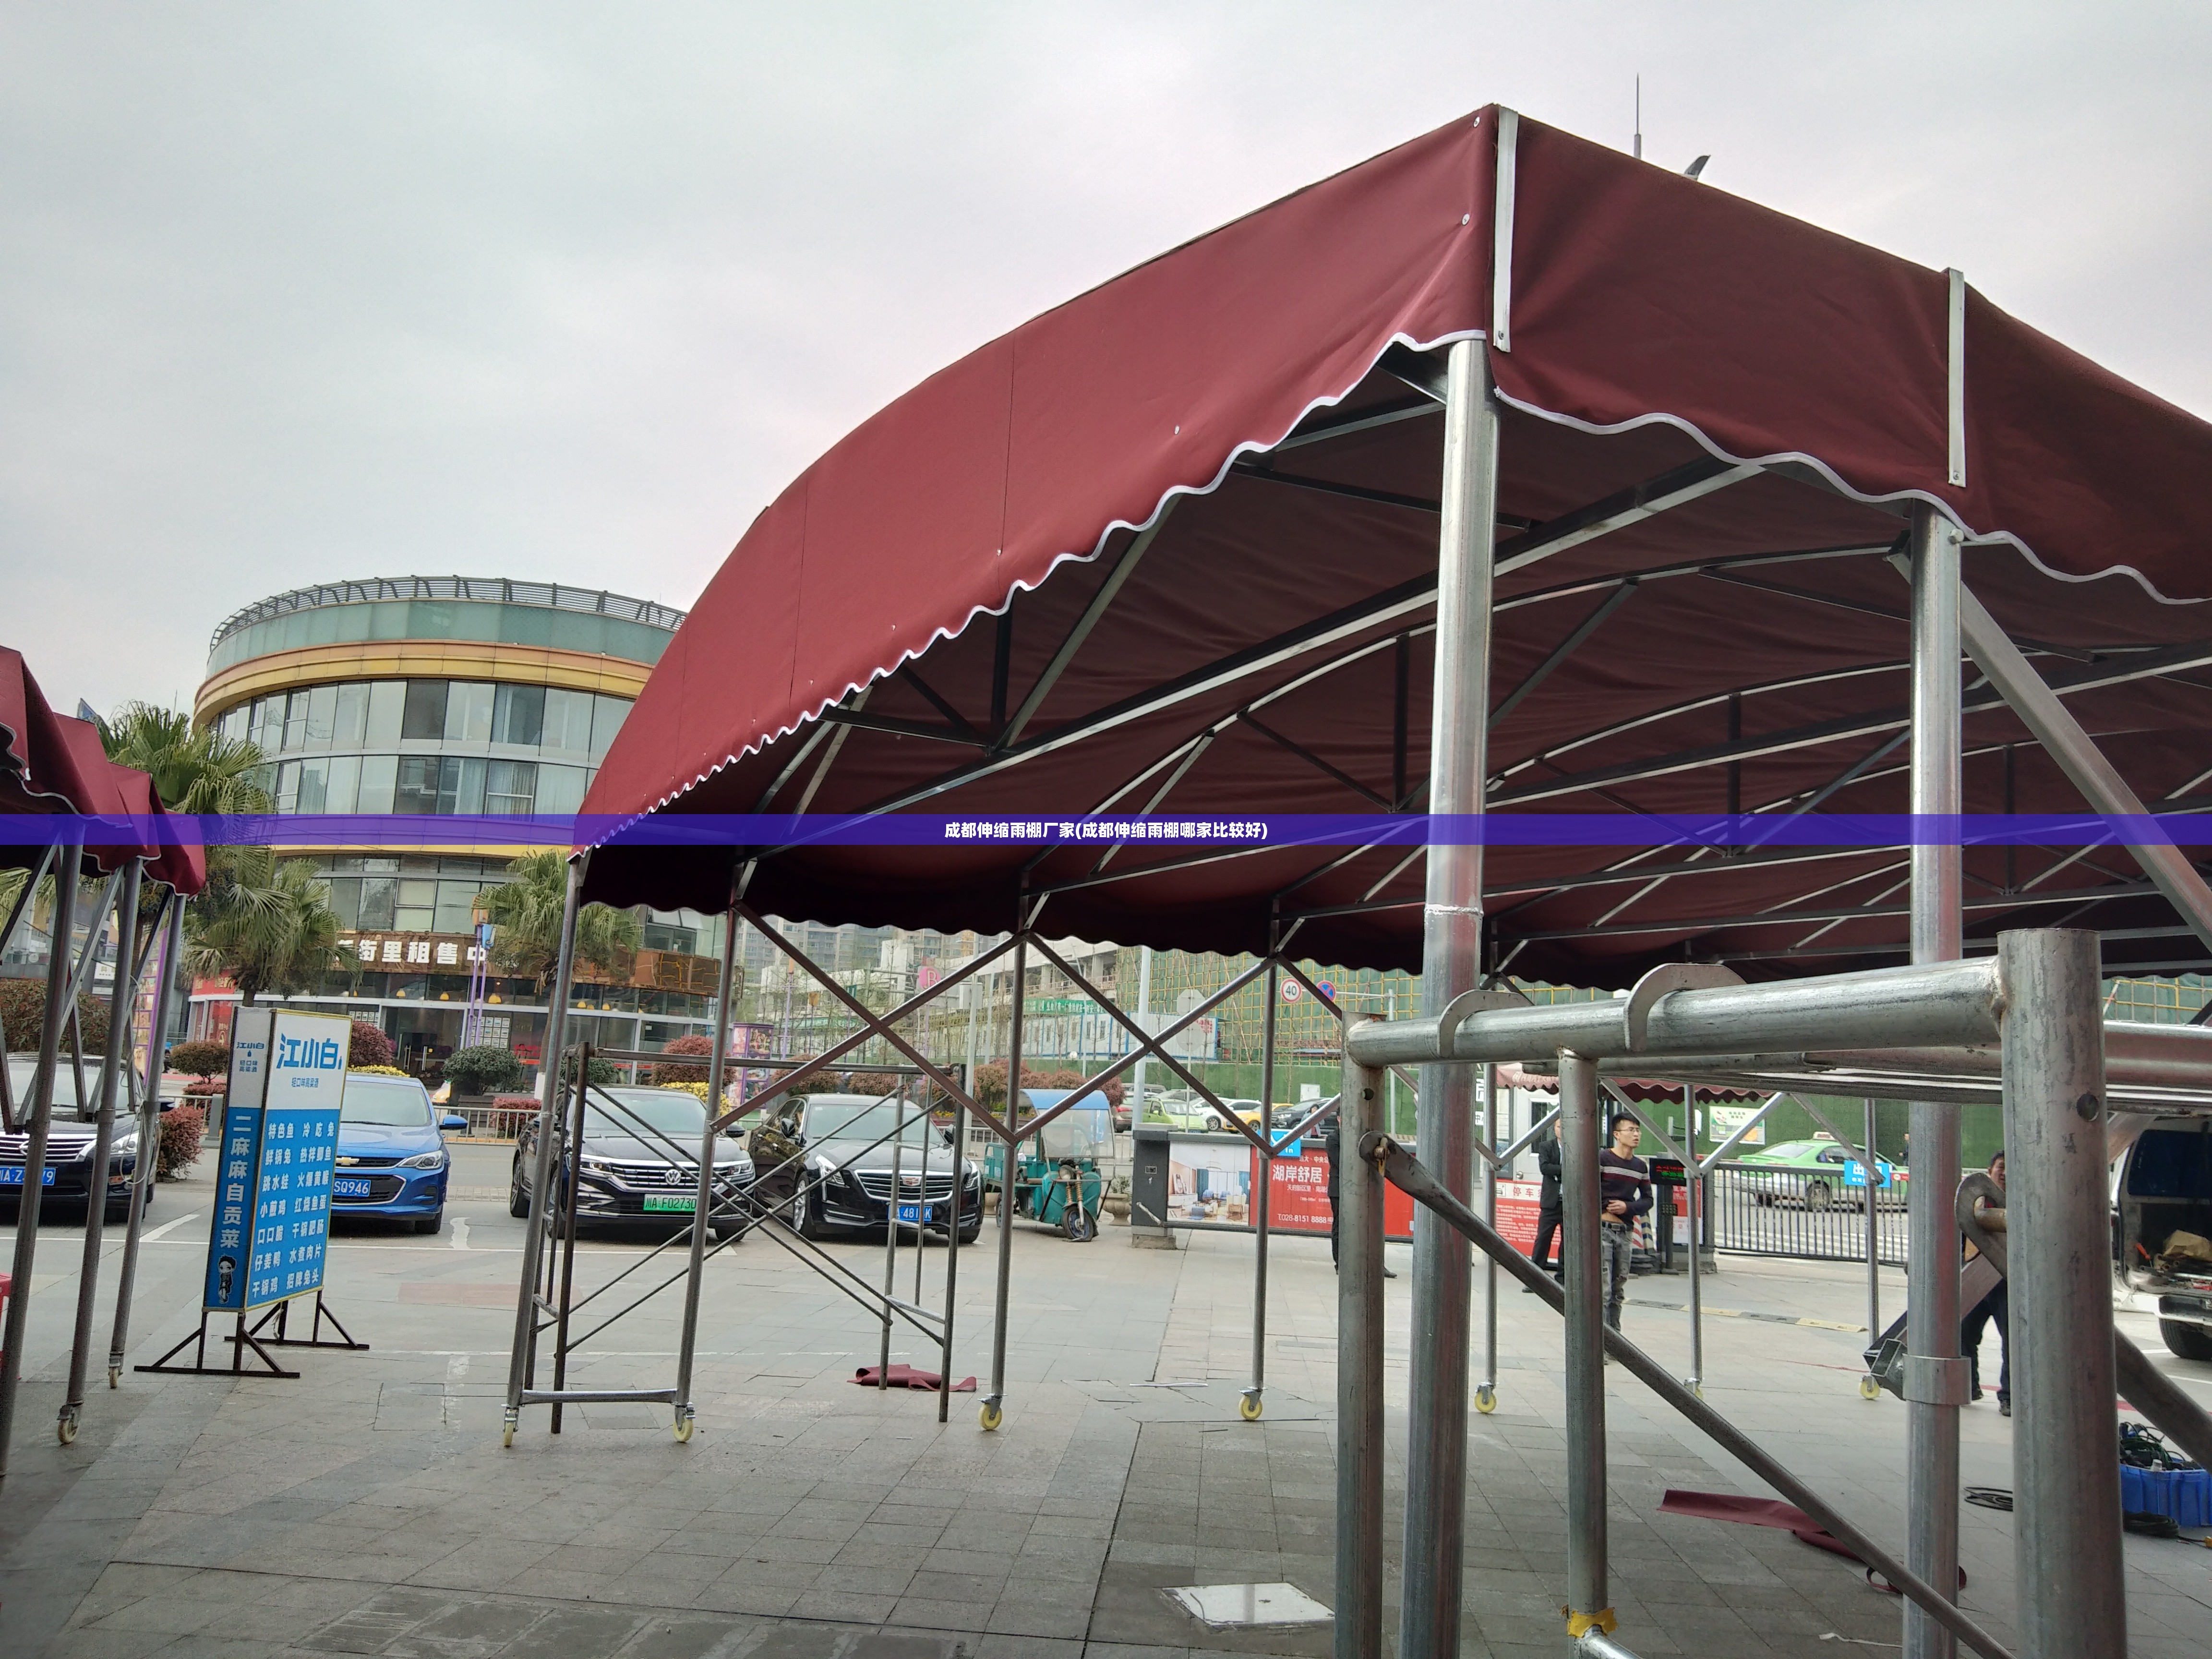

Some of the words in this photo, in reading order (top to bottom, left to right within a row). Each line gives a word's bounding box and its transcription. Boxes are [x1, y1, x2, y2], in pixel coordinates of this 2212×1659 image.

[1286, 985, 1297, 996] 40
[276, 1033, 339, 1069] 江小白
[291, 1077, 319, 1087] 轻口味高粱酒
[268, 1122, 294, 1140] 特色鱼
[265, 1148, 291, 1166] 鲜锅兔
[220, 1116, 252, 1248] 二麻麻自贡菜
[262, 1173, 289, 1192] 跳水蛙
[1273, 1164, 1322, 1183] 湖岸舒居
[260, 1199, 286, 1218] 小煎鸡
[294, 1194, 327, 1213] 红烧鱼蛋
[1311, 1215, 1327, 1224] 8888
[257, 1225, 284, 1245] 口口脆
[292, 1219, 324, 1238] 干锅肥肠
[255, 1250, 281, 1272] 仔姜鸭
[289, 1243, 322, 1264] 水煮肉片
[252, 1276, 278, 1298] 干锅鸡
[286, 1267, 319, 1290] 招牌兔头
